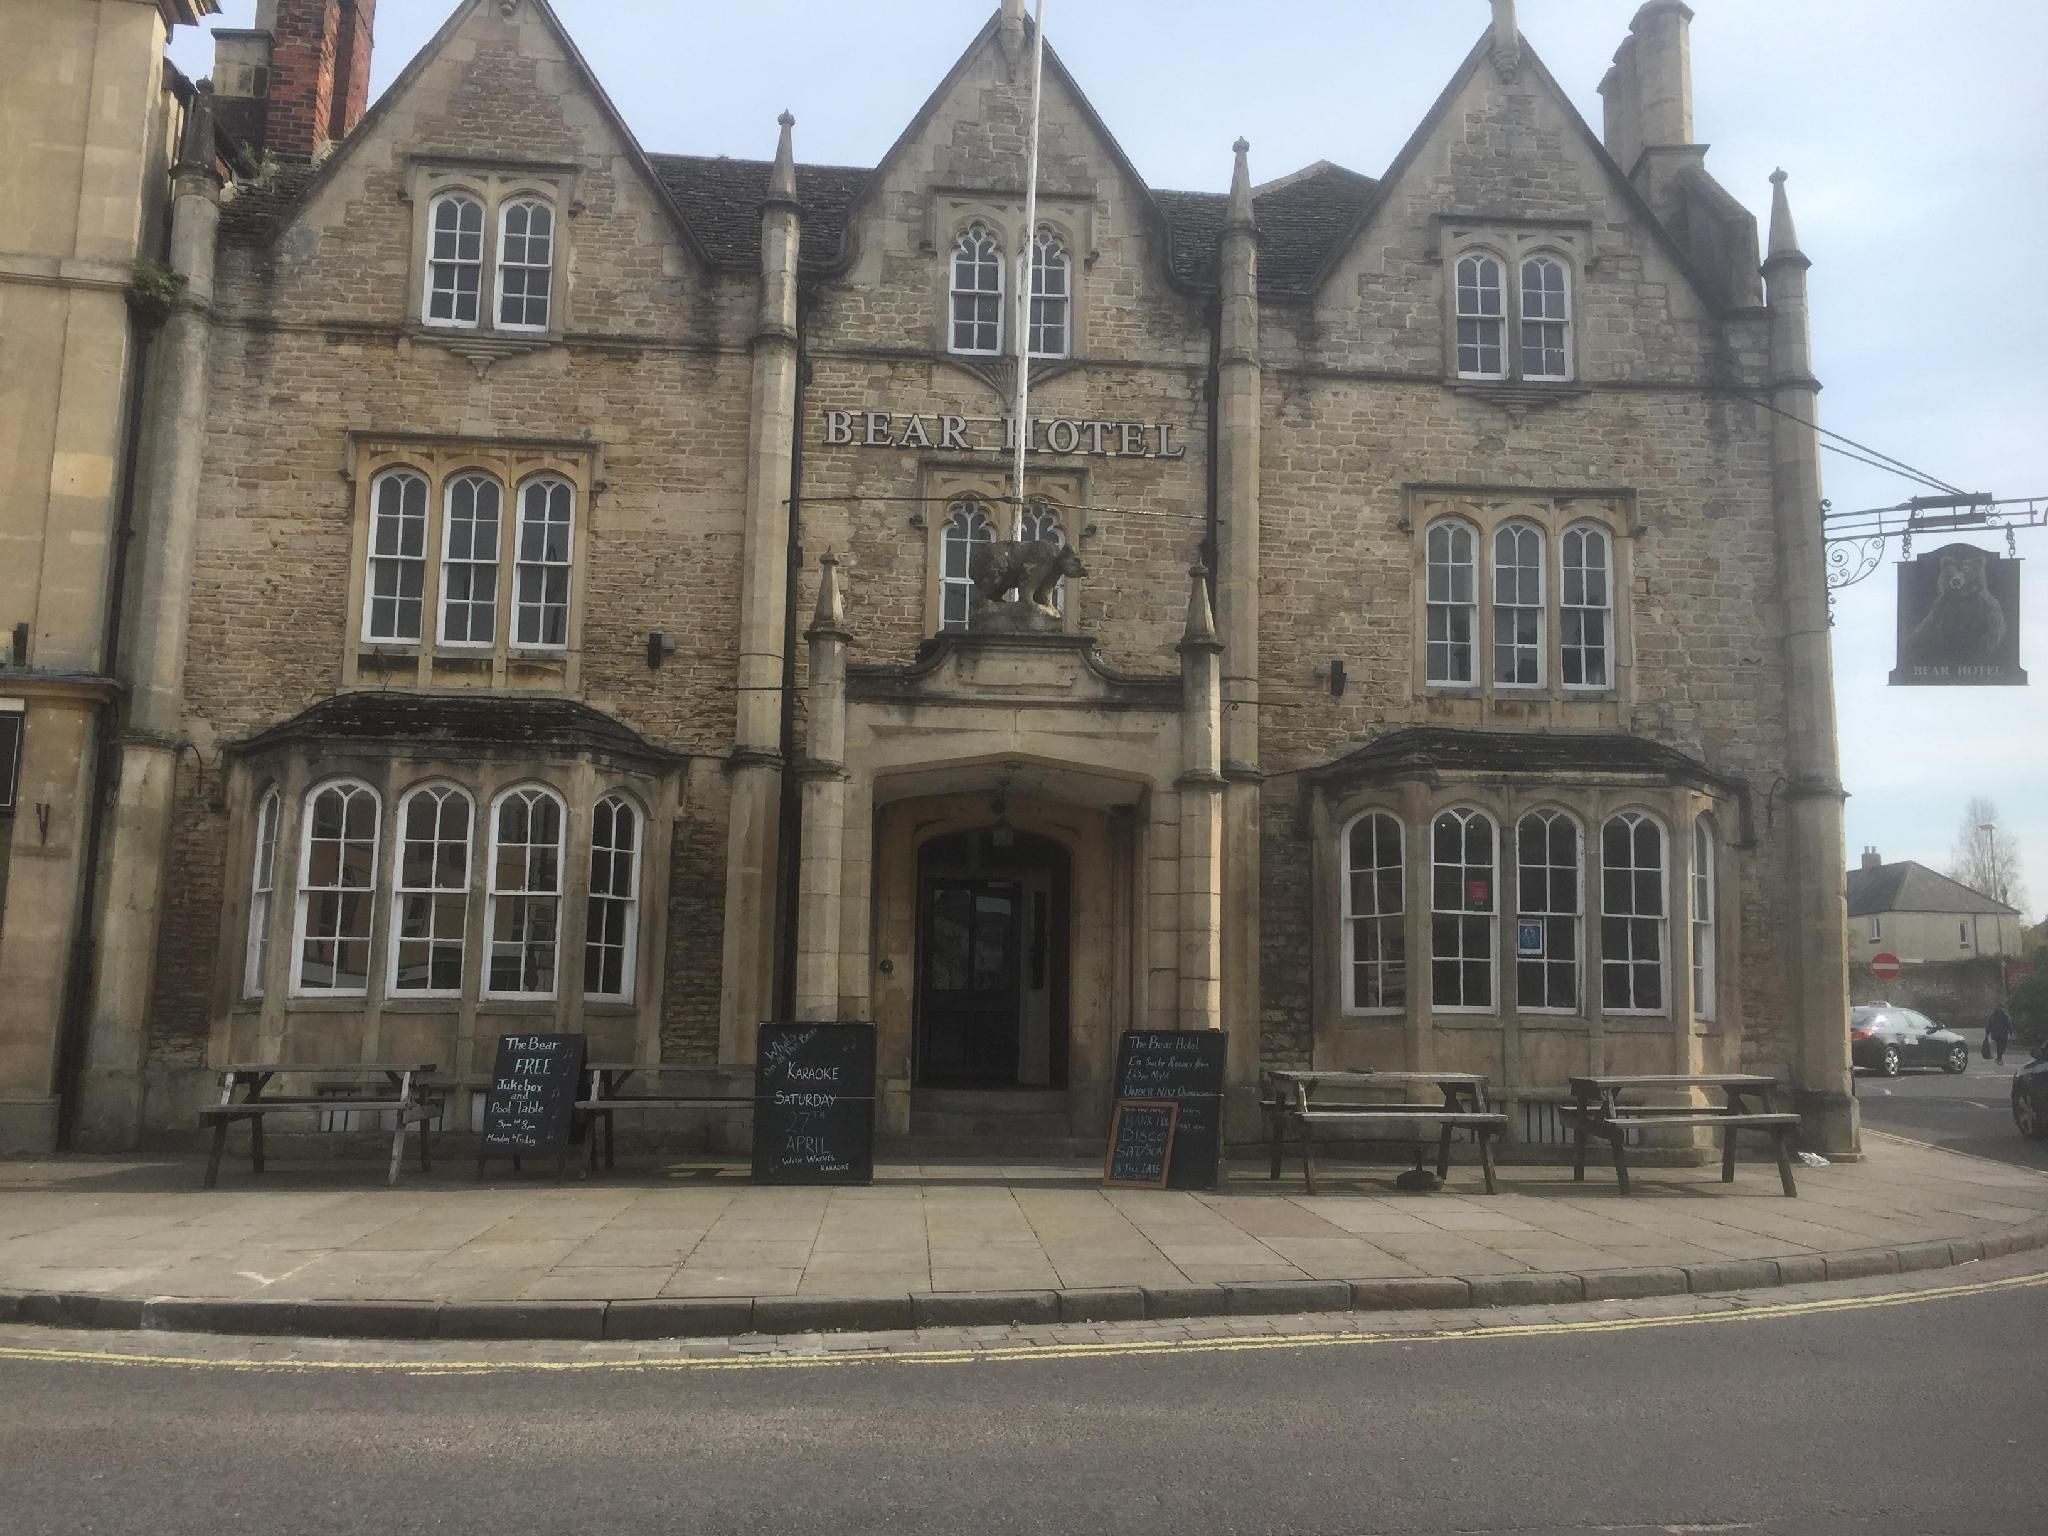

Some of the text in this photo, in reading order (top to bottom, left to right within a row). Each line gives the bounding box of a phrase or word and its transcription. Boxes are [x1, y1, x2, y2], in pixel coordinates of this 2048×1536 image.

[822, 410, 1186, 458] BEAR HOTEL
[1913, 665, 2004, 676] BEAR HOTEL
[505, 1036, 561, 1050] The Bear
[1128, 1034, 1200, 1050] The Bear Hotel
[514, 1058, 553, 1075] FREE
[787, 1061, 840, 1080] KARAOKE
[497, 1078, 543, 1092] Jukebox
[510, 1091, 529, 1100] and
[491, 1100, 544, 1114] Pool Table
[496, 1119, 512, 1129] 5pm
[521, 1119, 536, 1130] 8pm
[486, 1133, 511, 1145] Monday
[516, 1133, 536, 1146] Friday
[785, 1135, 830, 1154] APRIL
